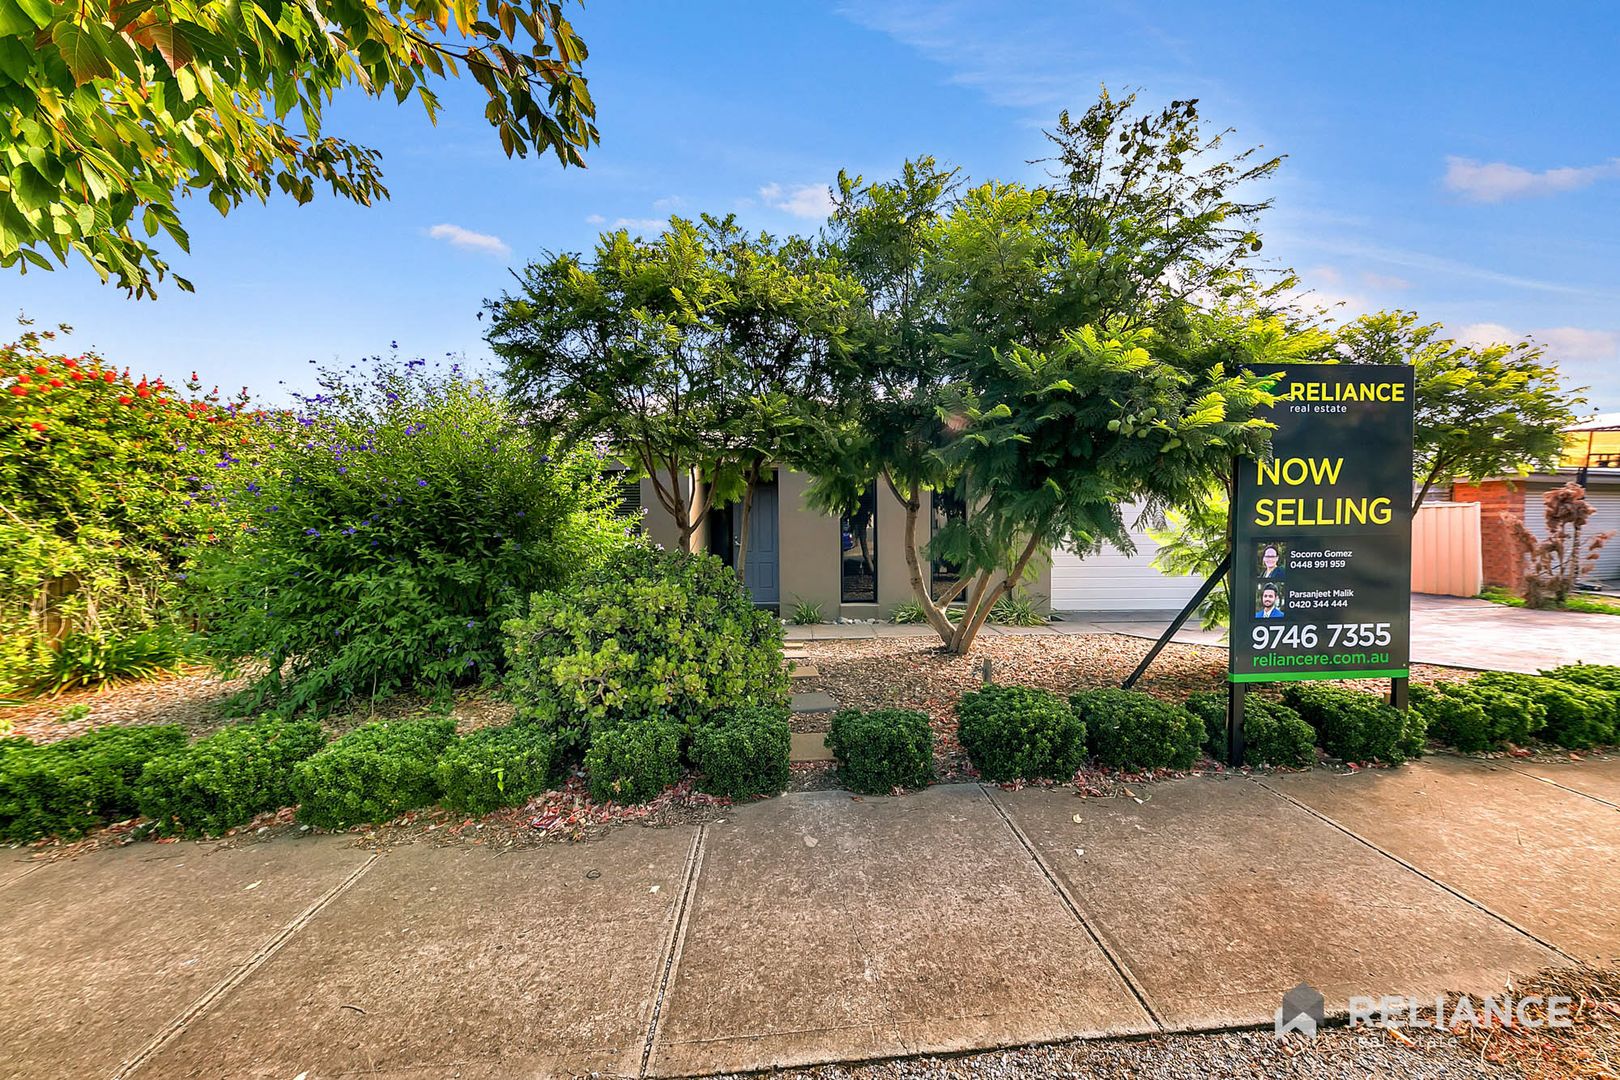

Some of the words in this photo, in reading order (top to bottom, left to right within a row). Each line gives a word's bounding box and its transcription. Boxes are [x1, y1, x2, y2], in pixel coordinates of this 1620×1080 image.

[1290, 382, 1405, 402] RELIANCE
[1290, 404, 1310, 413] real
[1314, 405, 1347, 413] estate
[1257, 457, 1344, 486] NOW
[1254, 497, 1392, 526] SELLING
[1290, 550, 1322, 558] Socorro
[1324, 550, 1352, 558] Gomez
[1290, 561, 1313, 569] 0448
[1315, 560, 1328, 568] 991
[1330, 560, 1346, 568] 959
[1289, 590, 1331, 598] Parsanjeet
[1333, 589, 1354, 597] Malik
[1289, 601, 1311, 609] 0420
[1313, 600, 1329, 608] 344
[1331, 600, 1348, 608] 444
[1252, 624, 1318, 650] 9746
[1327, 623, 1391, 648] 7355
[1253, 652, 1389, 667] reliancere.com.au
